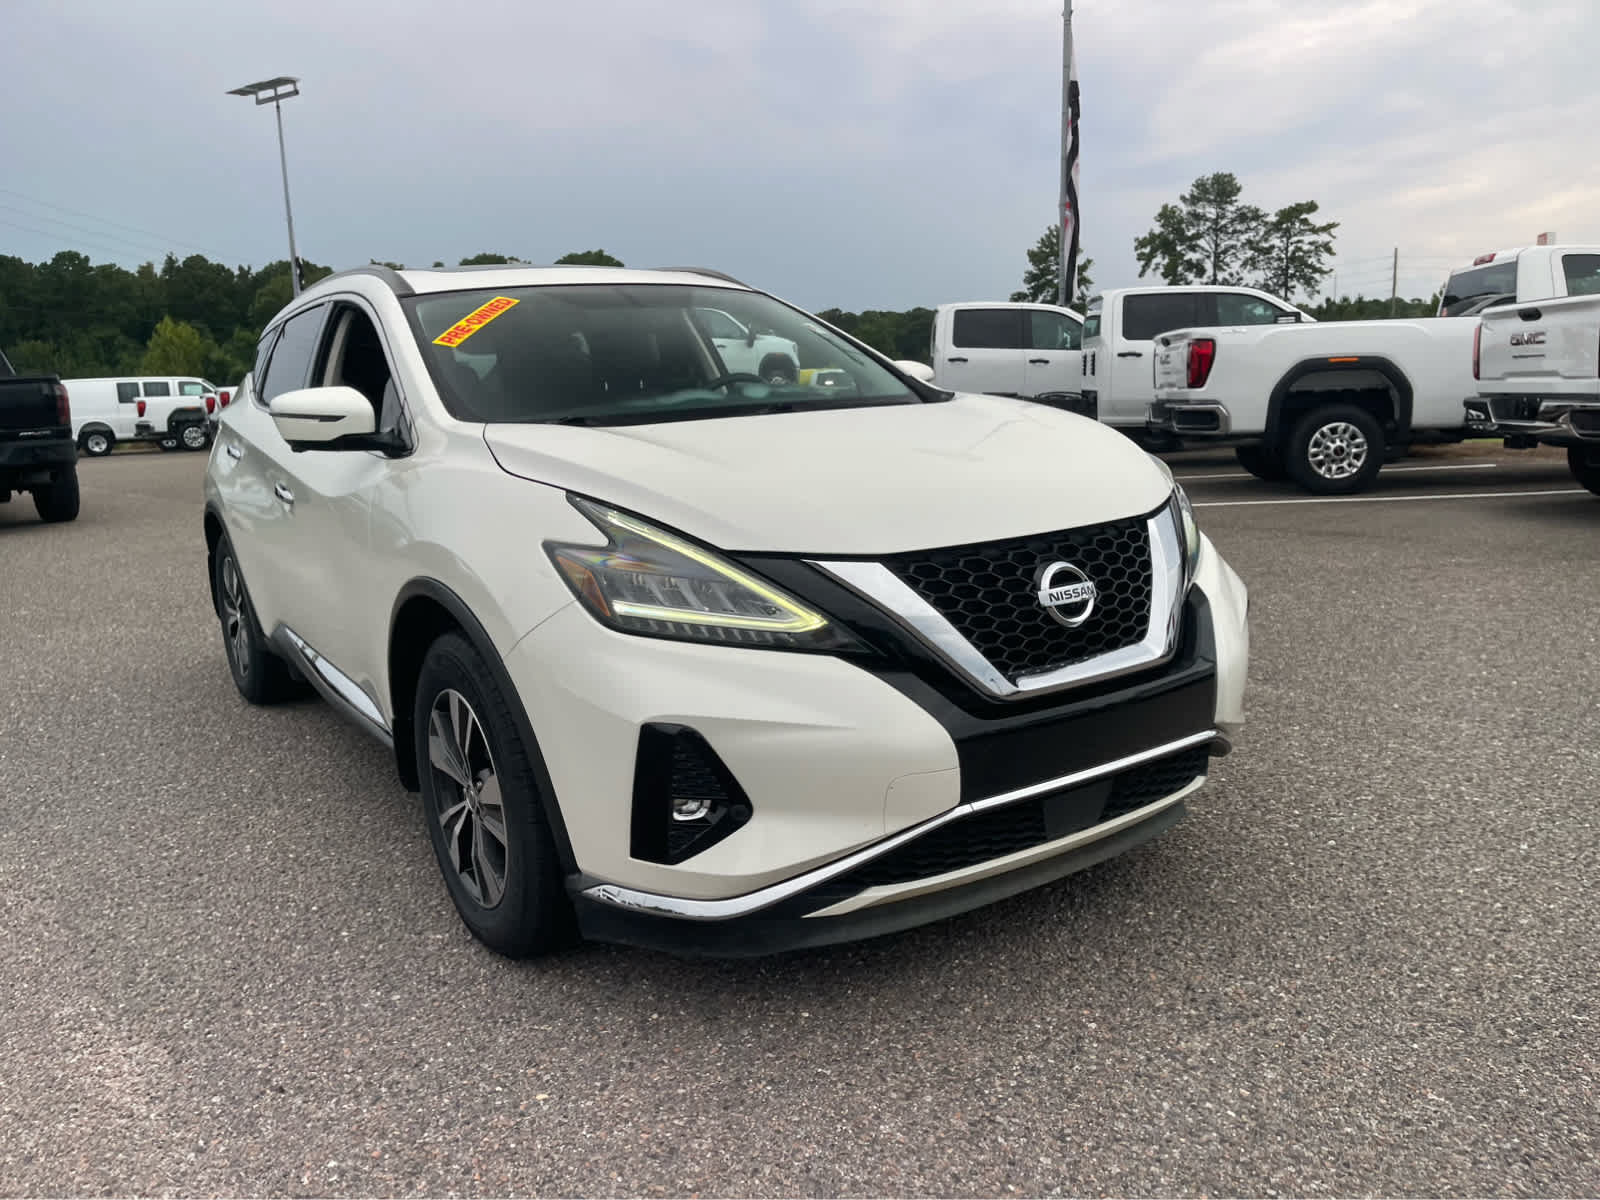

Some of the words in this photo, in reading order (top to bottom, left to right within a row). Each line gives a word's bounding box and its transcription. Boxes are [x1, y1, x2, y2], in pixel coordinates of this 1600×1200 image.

[438, 298, 513, 346] PRE-OWNED
[1510, 331, 1545, 346] GMC
[1048, 584, 1095, 602] NISSAN
